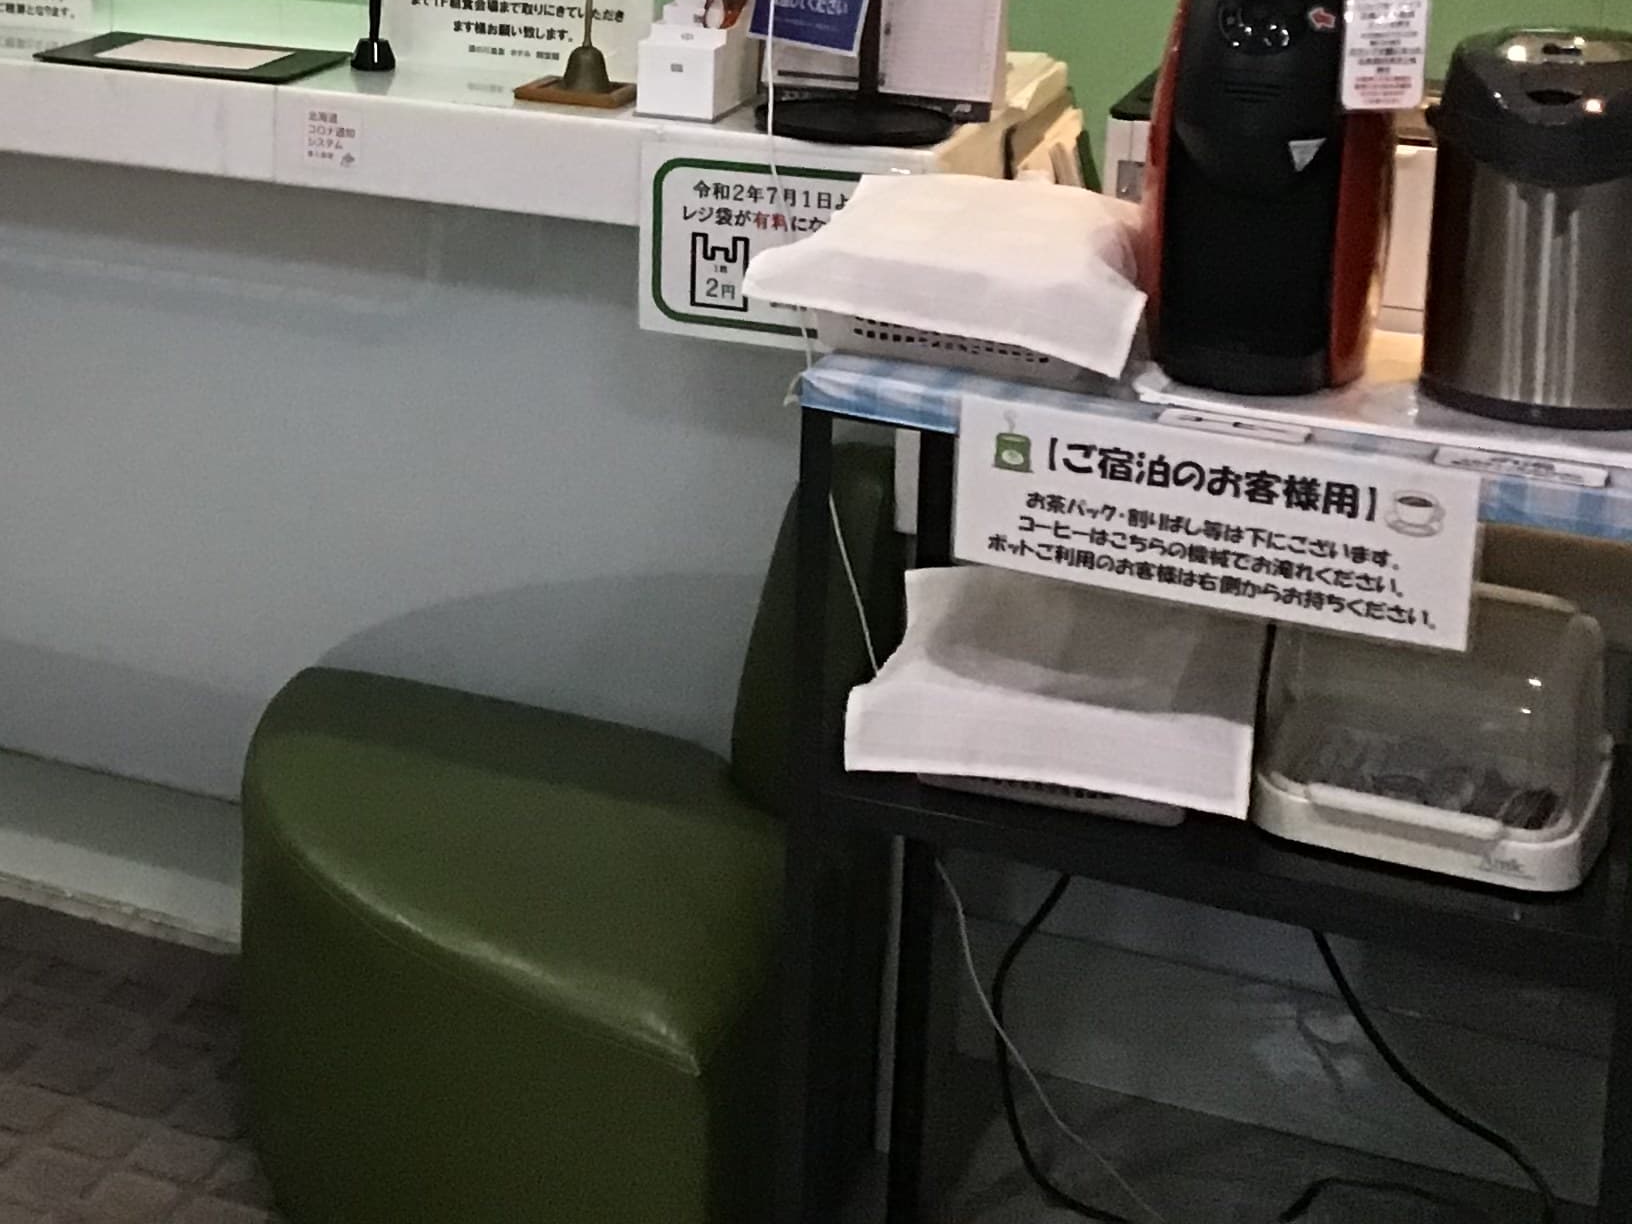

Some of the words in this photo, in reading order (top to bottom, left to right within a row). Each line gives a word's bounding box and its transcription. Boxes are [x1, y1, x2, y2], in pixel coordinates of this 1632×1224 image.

[705, 278, 736, 301] 2円
[1048, 437, 1378, 522] 【ご宿泊のお客様用】
